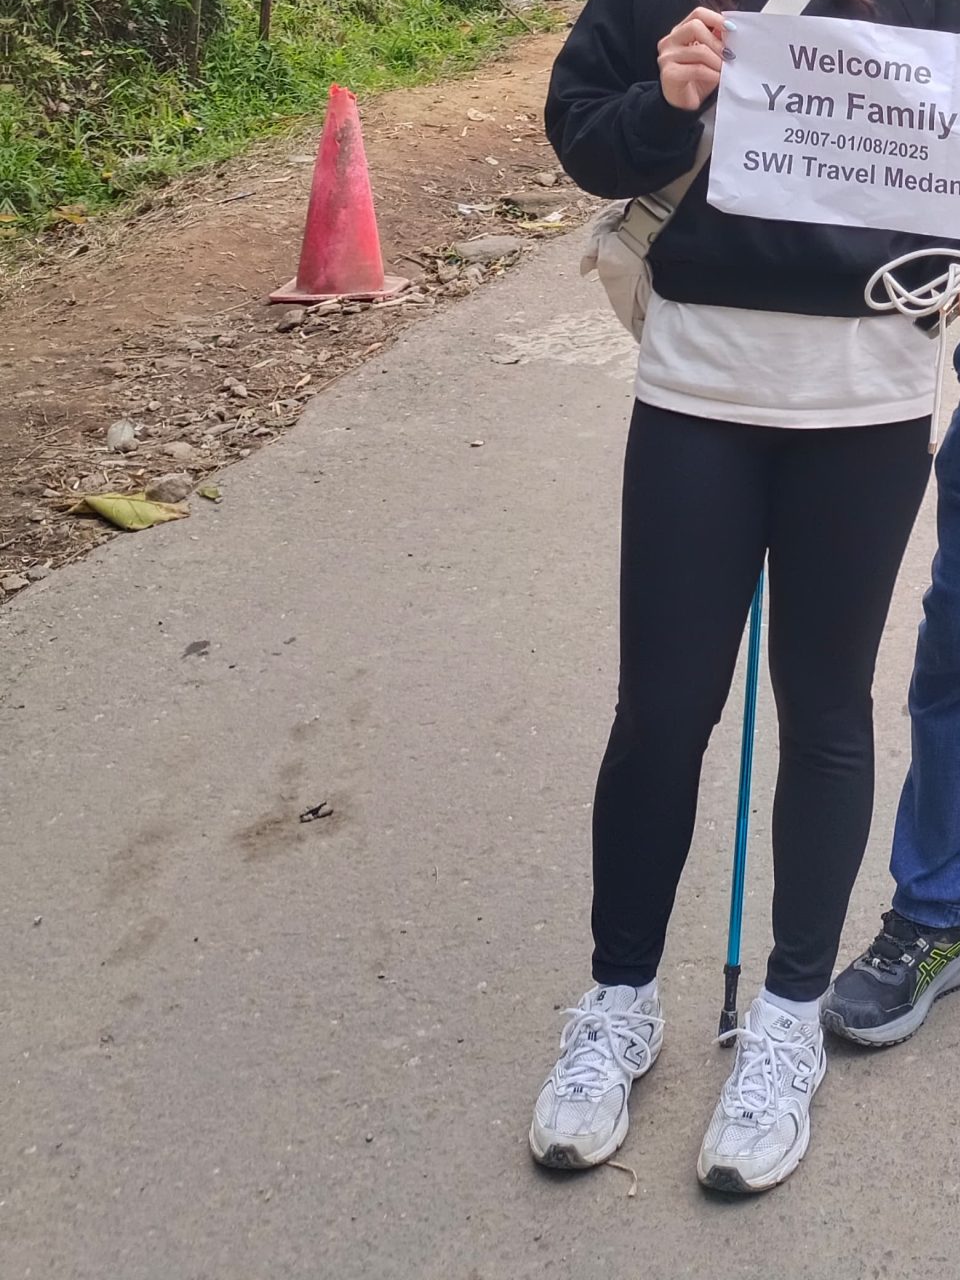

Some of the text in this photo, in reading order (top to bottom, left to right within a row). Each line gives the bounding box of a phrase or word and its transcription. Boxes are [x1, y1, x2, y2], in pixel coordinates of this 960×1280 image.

[788, 43, 932, 84] Welcome
[762, 83, 958, 139] Yam Family
[783, 127, 929, 161] 29/07-01/08/2025
[743, 150, 793, 175] SWI
[802, 156, 876, 185] Travel
